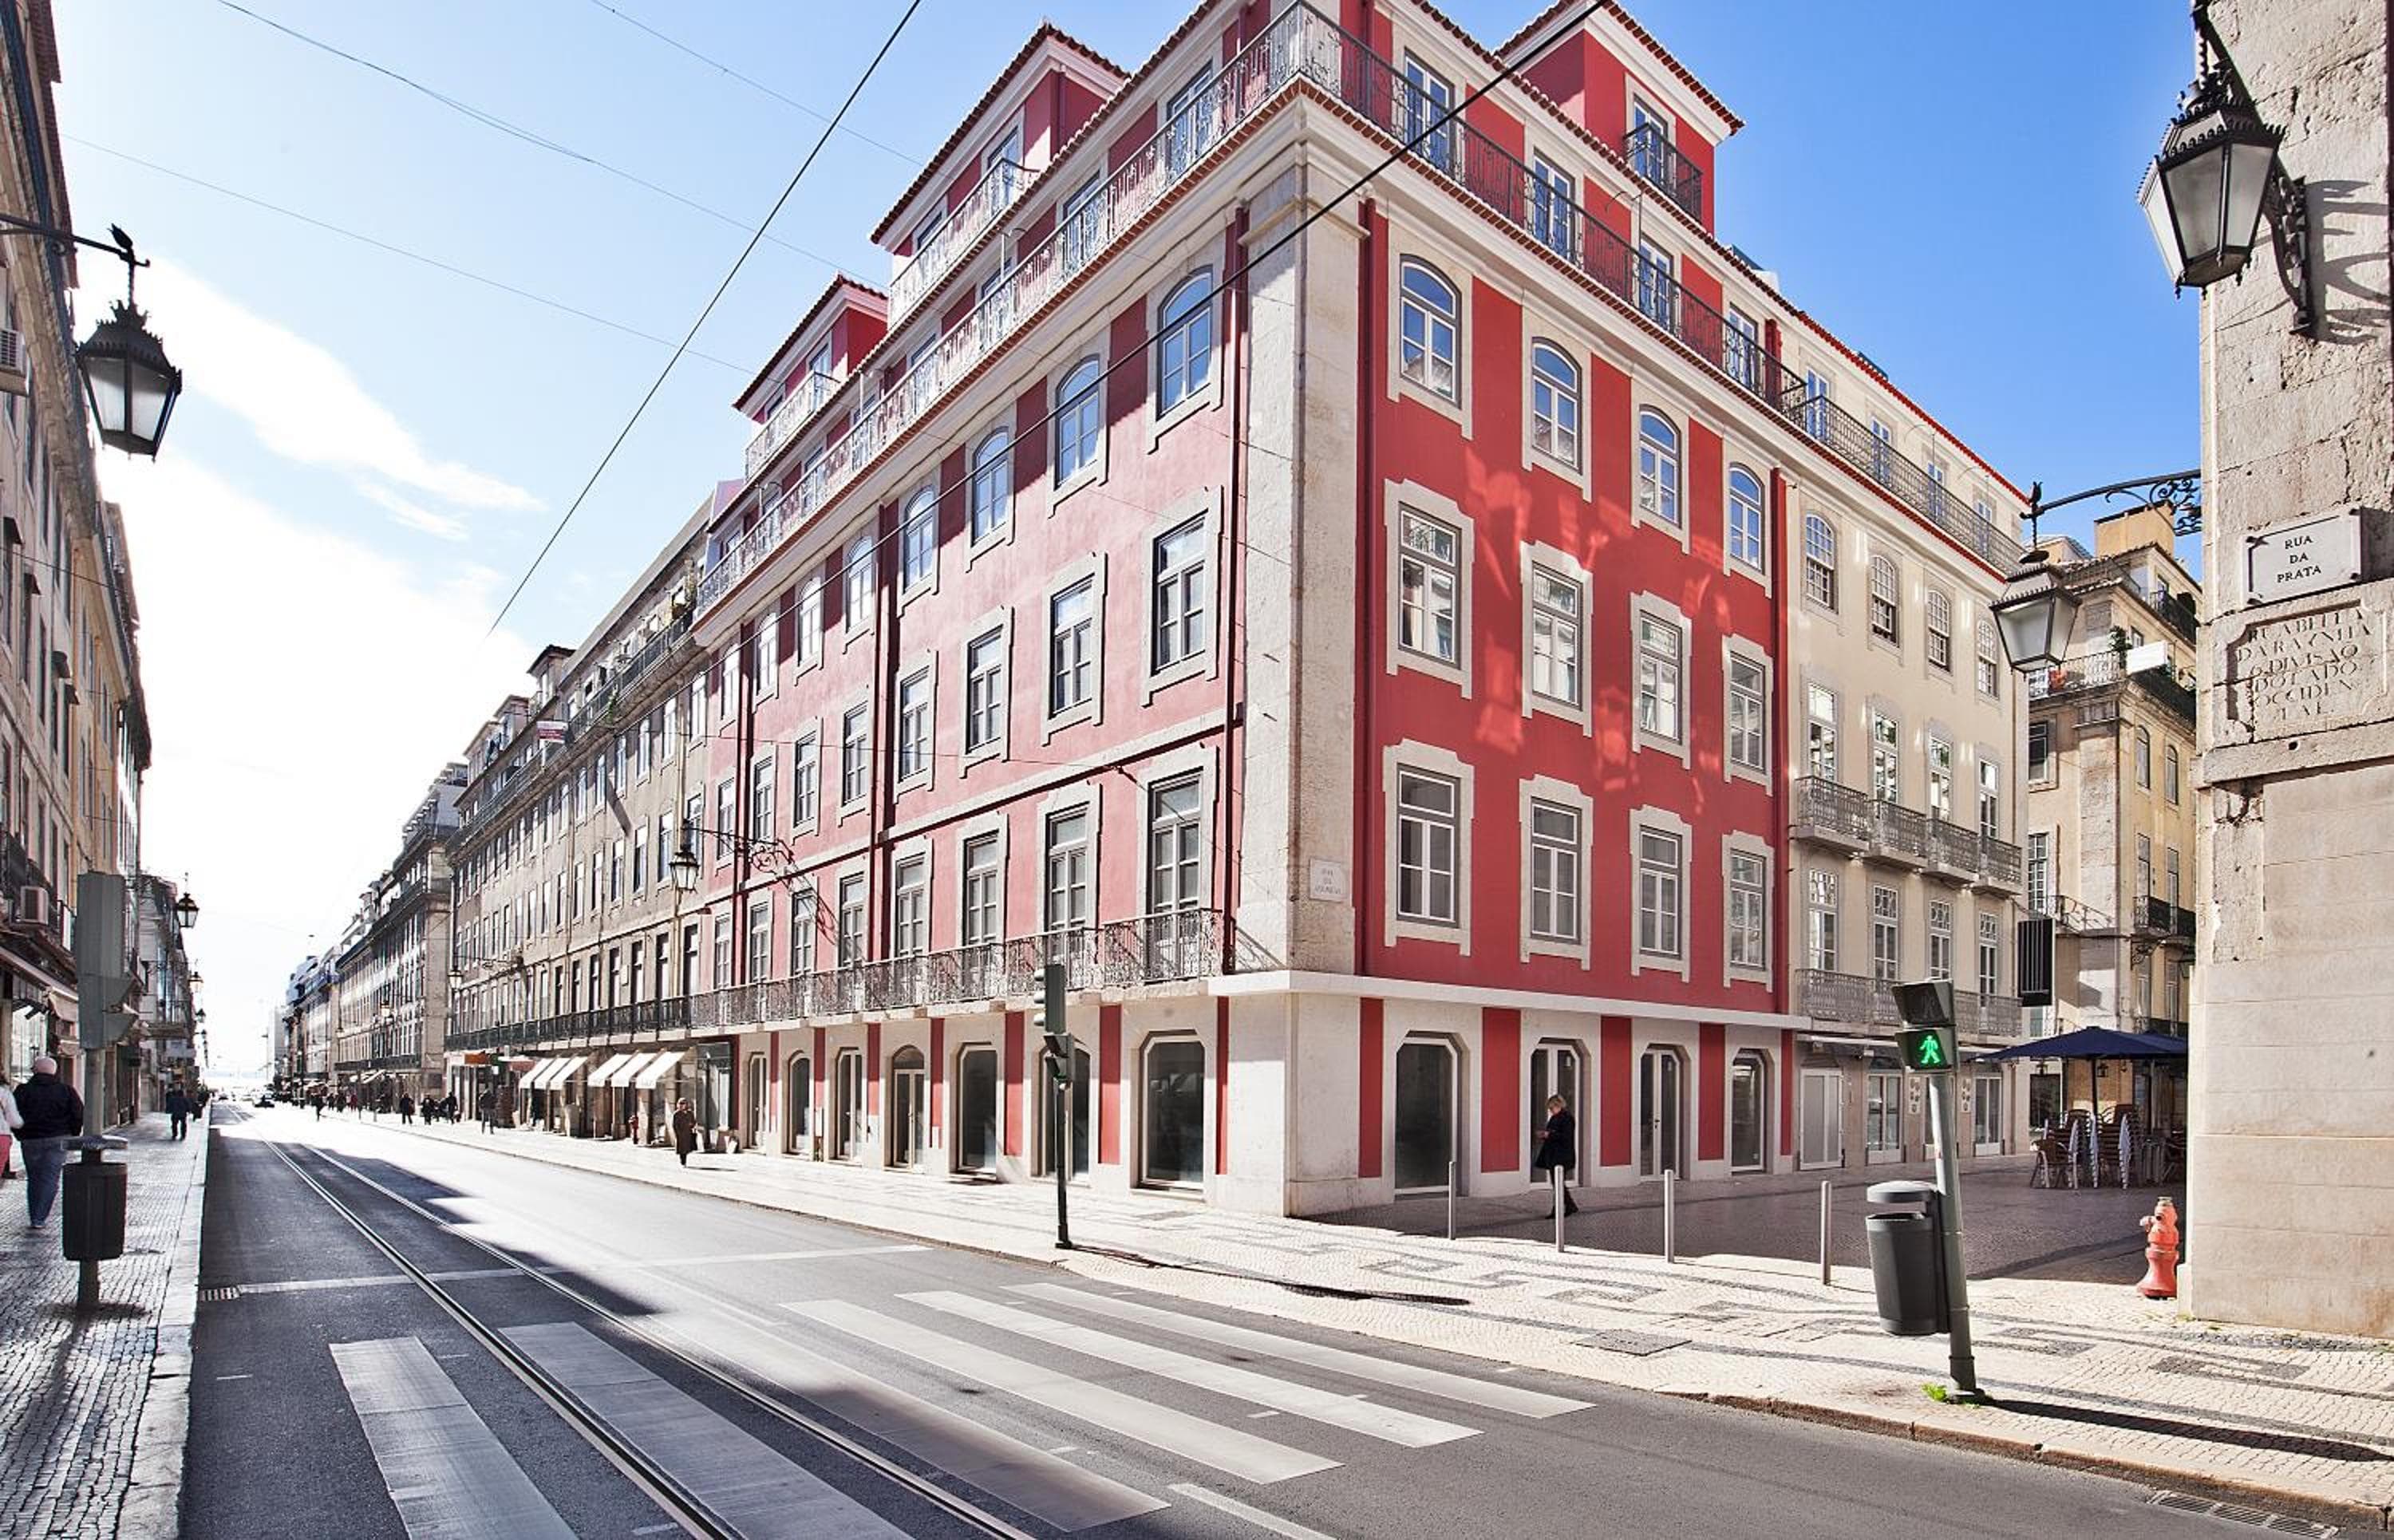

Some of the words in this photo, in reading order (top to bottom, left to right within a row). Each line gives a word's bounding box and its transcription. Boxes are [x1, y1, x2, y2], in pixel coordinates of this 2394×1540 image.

[2285, 535, 2313, 549] RUA
[2289, 552, 2309, 564] DA
[2277, 565, 2321, 583] PRATA
